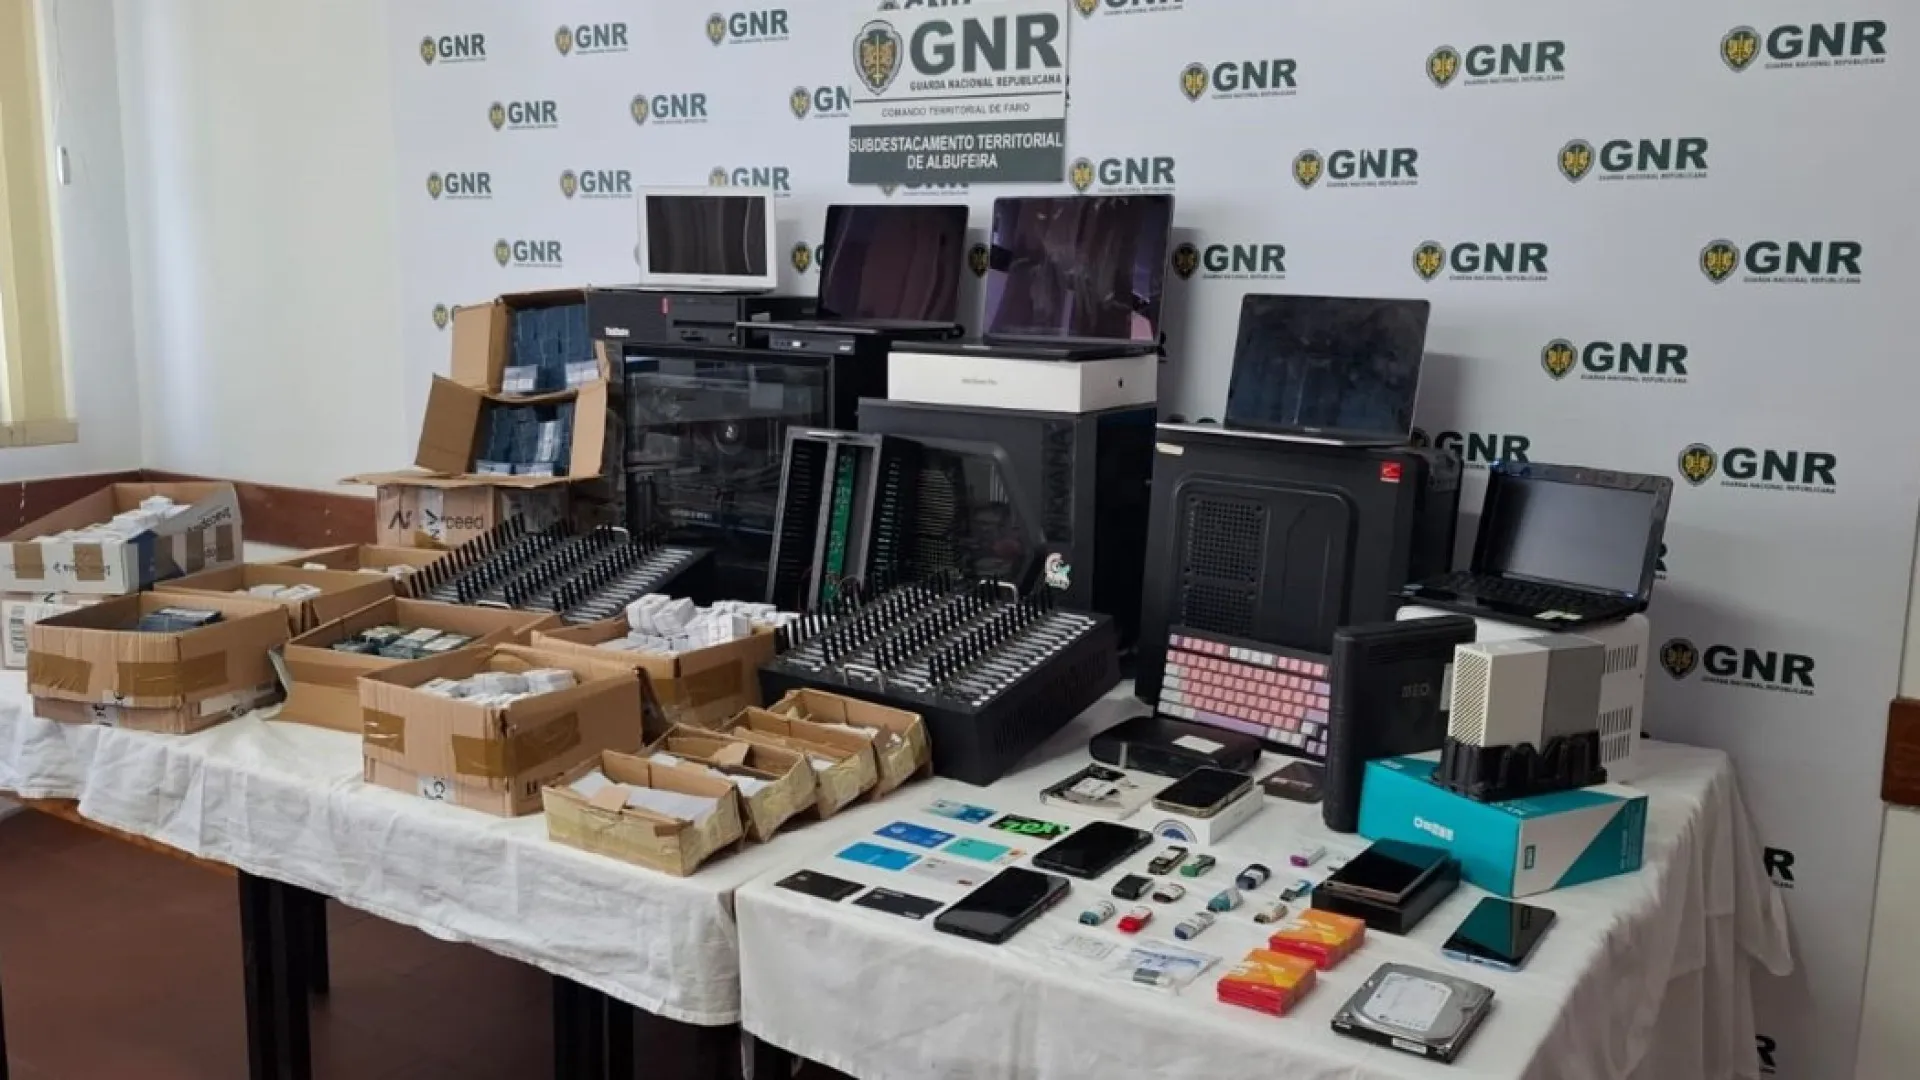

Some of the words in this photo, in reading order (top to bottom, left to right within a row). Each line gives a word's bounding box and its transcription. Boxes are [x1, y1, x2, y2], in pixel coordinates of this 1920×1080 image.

[576, 22, 628, 48] GNR
[729, 9, 789, 37] GNR
[439, 33, 486, 57] GNR
[910, 13, 1062, 75] GNR
[1766, 20, 1887, 60] GNR
[1465, 40, 1565, 77] GNR
[910, 80, 945, 91] GUARDA
[947, 77, 993, 89] NACIONAL
[996, 74, 1062, 87] REPUBLICANA
[1212, 58, 1297, 91] GNR
[508, 100, 557, 124] GNR
[652, 93, 707, 118] GNR
[814, 86, 851, 112] GN
[881, 106, 926, 118] COMANDO
[929, 104, 986, 116] TERRITORIAL
[989, 104, 1001, 114] DE
[850, 134, 974, 153] SUBDESTACAMENTO
[978, 132, 1063, 149] TERRITORIAL
[1600, 137, 1708, 172] GNR
[907, 154, 924, 170] DE
[925, 153, 998, 170] ALBUFEIRA
[1099, 156, 1176, 186] GNR
[1328, 147, 1418, 179] GNR
[445, 172, 491, 194] GNR
[580, 170, 632, 193] GNR
[514, 240, 562, 262] GNR
[1203, 244, 1286, 272] GNR
[1450, 242, 1548, 273] GNR
[1744, 241, 1862, 275] GNR
[1582, 341, 1688, 375] GNR
[1722, 447, 1836, 485] GNR
[1703, 644, 1814, 687] GNR
